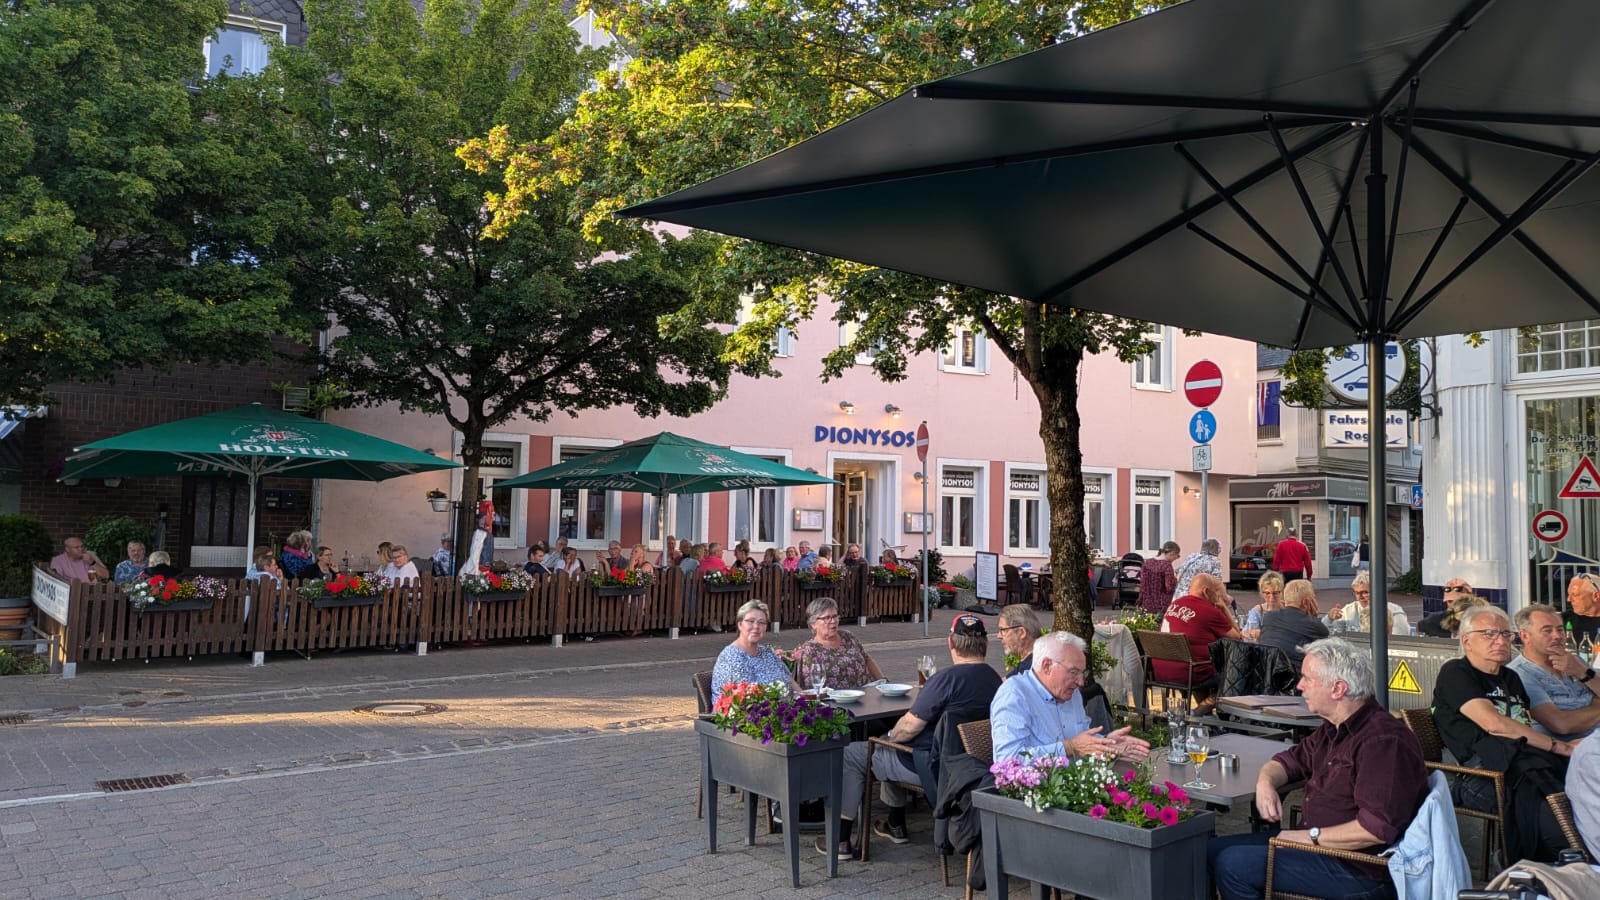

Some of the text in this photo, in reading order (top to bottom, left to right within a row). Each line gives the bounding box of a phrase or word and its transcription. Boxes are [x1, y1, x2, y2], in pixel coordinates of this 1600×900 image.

[1329, 415, 1404, 425] Fahrsule
[815, 425, 915, 447] DIONYSOS
[1344, 430, 1389, 442] Rog
[219, 443, 348, 457] HOLSTEN
[480, 455, 513, 465] NYSOS
